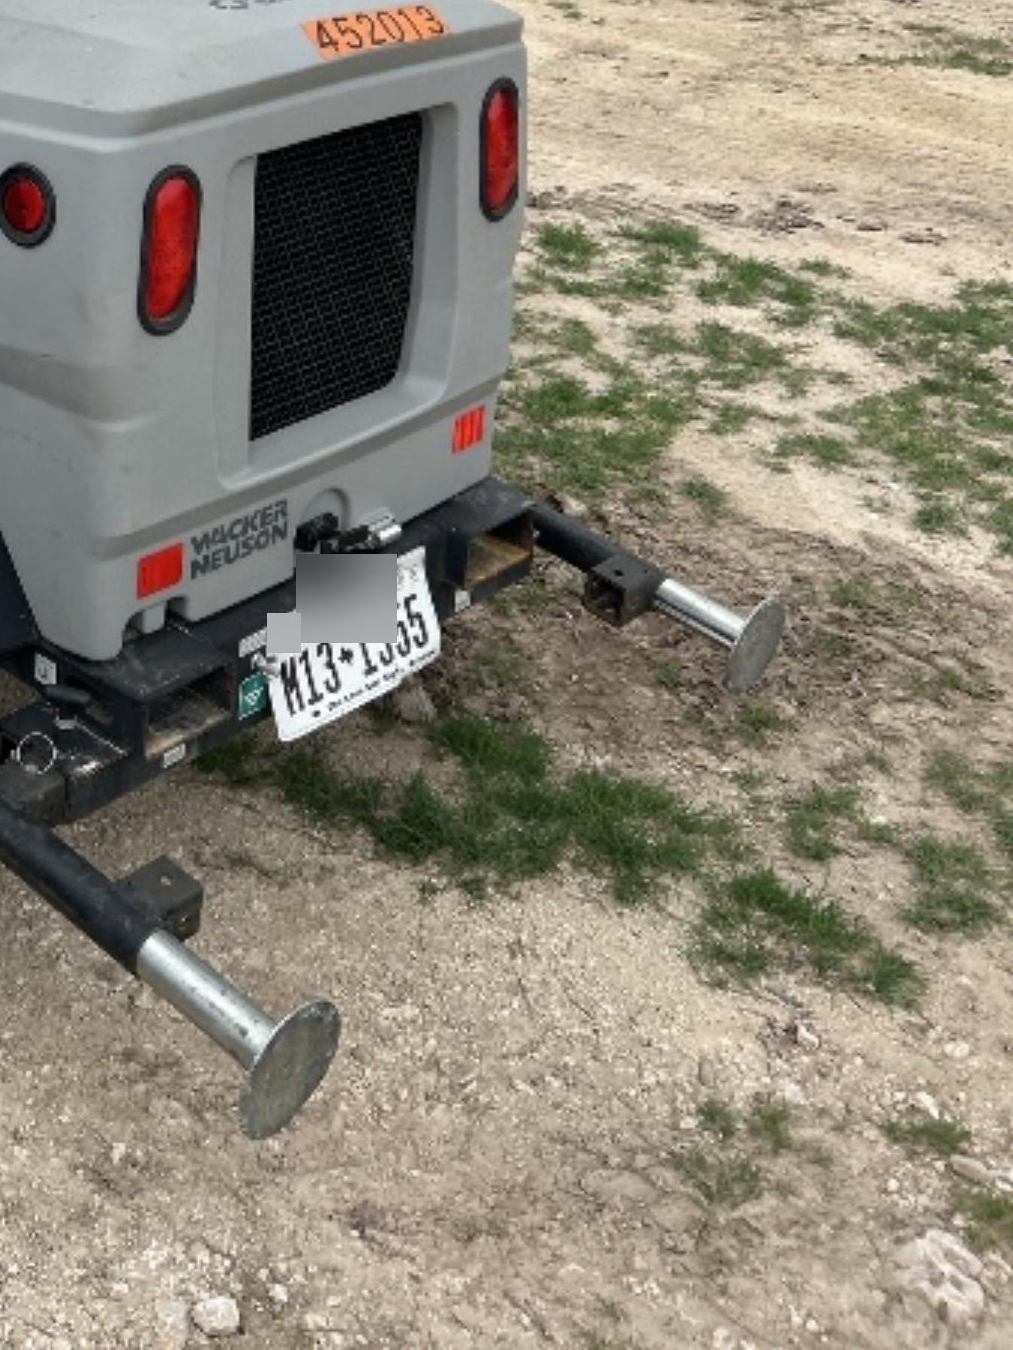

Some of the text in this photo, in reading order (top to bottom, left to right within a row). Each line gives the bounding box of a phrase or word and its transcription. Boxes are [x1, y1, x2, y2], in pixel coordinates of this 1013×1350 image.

[315, 4, 445, 52] 452013
[190, 498, 288, 555] WACKER
[190, 521, 288, 581] NEUSON
